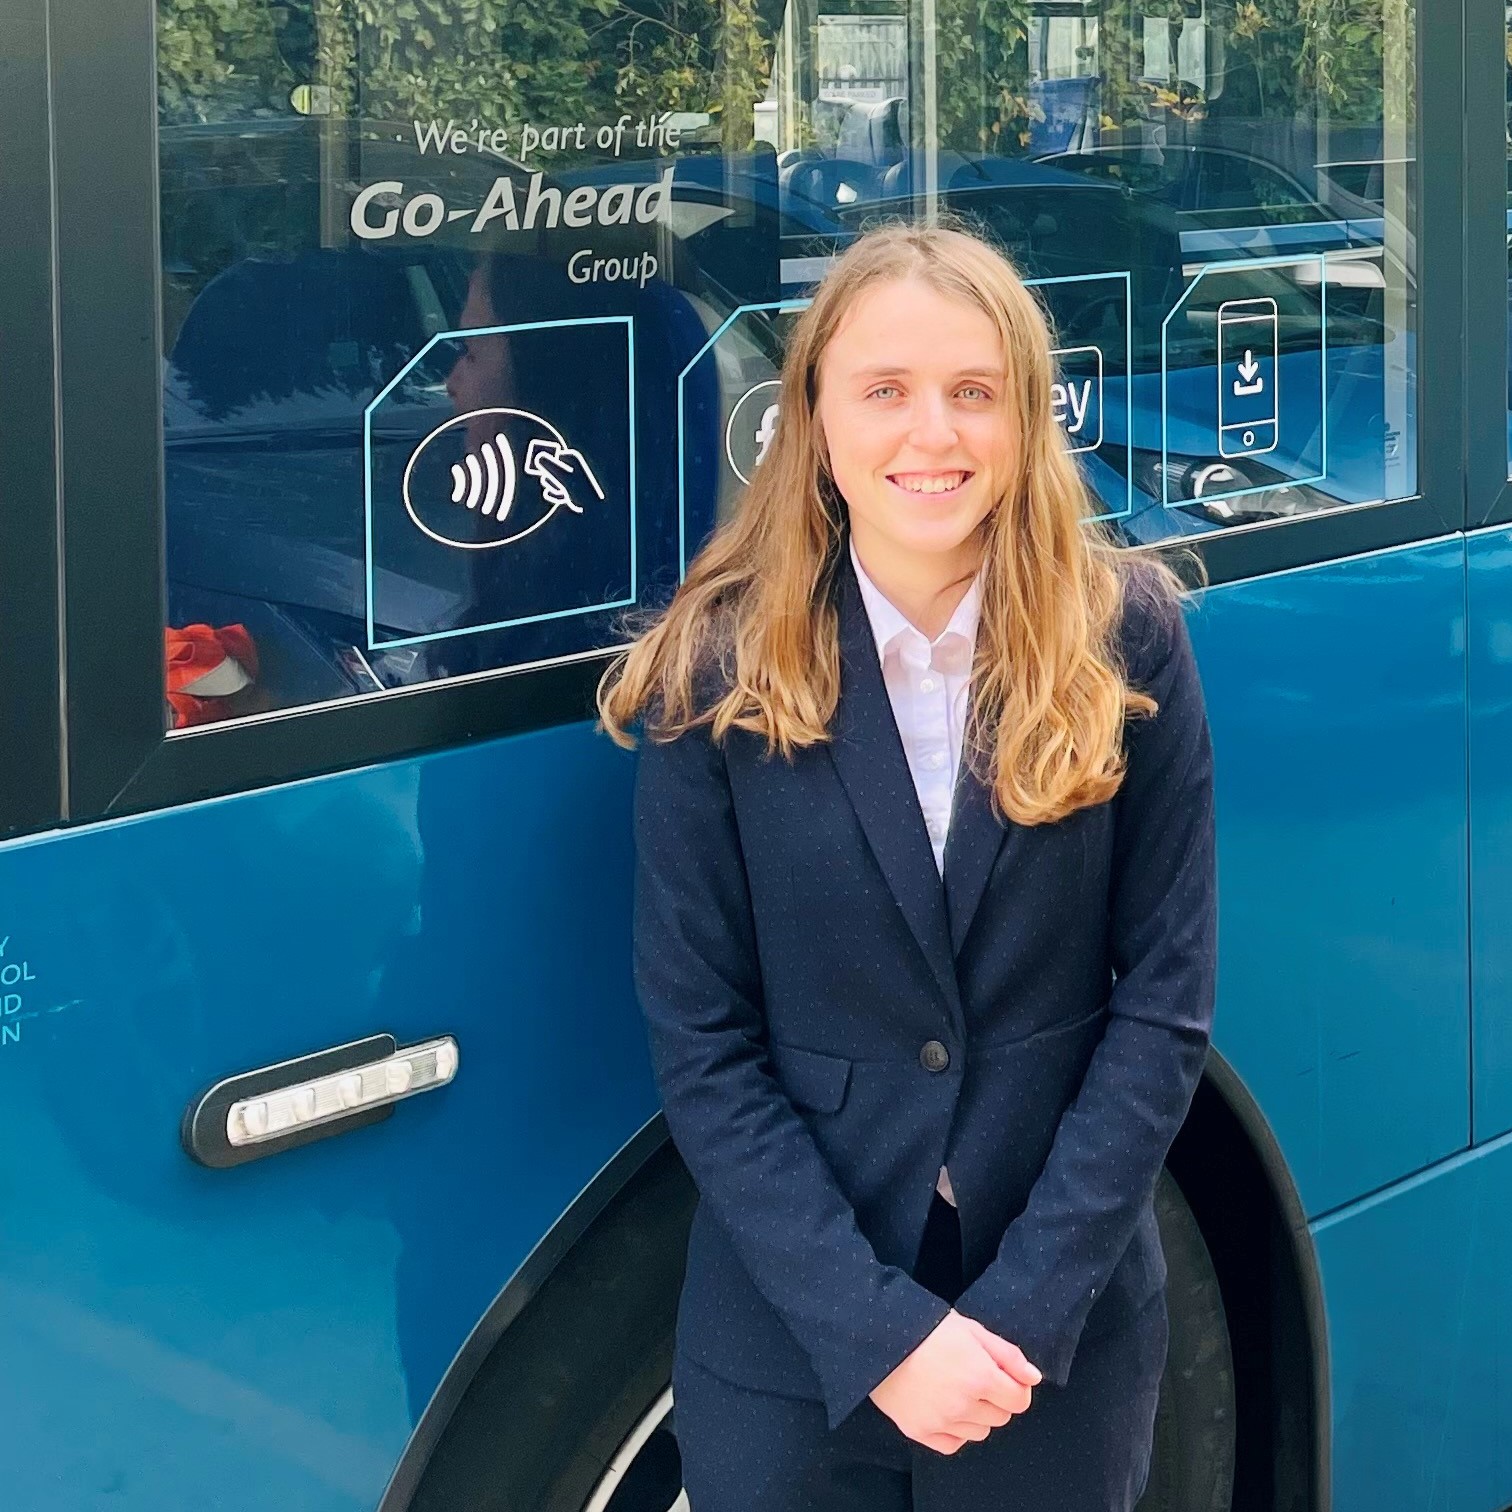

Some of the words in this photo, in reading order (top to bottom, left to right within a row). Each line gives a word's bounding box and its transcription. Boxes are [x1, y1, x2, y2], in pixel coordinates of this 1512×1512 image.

[413, 118, 509, 155] We’re
[520, 122, 587, 162] part
[596, 114, 632, 156] of
[635, 114, 681, 148] the
[350, 166, 676, 240] Go-Ahead
[567, 249, 659, 289] Group
[1050, 379, 1092, 433] ey
